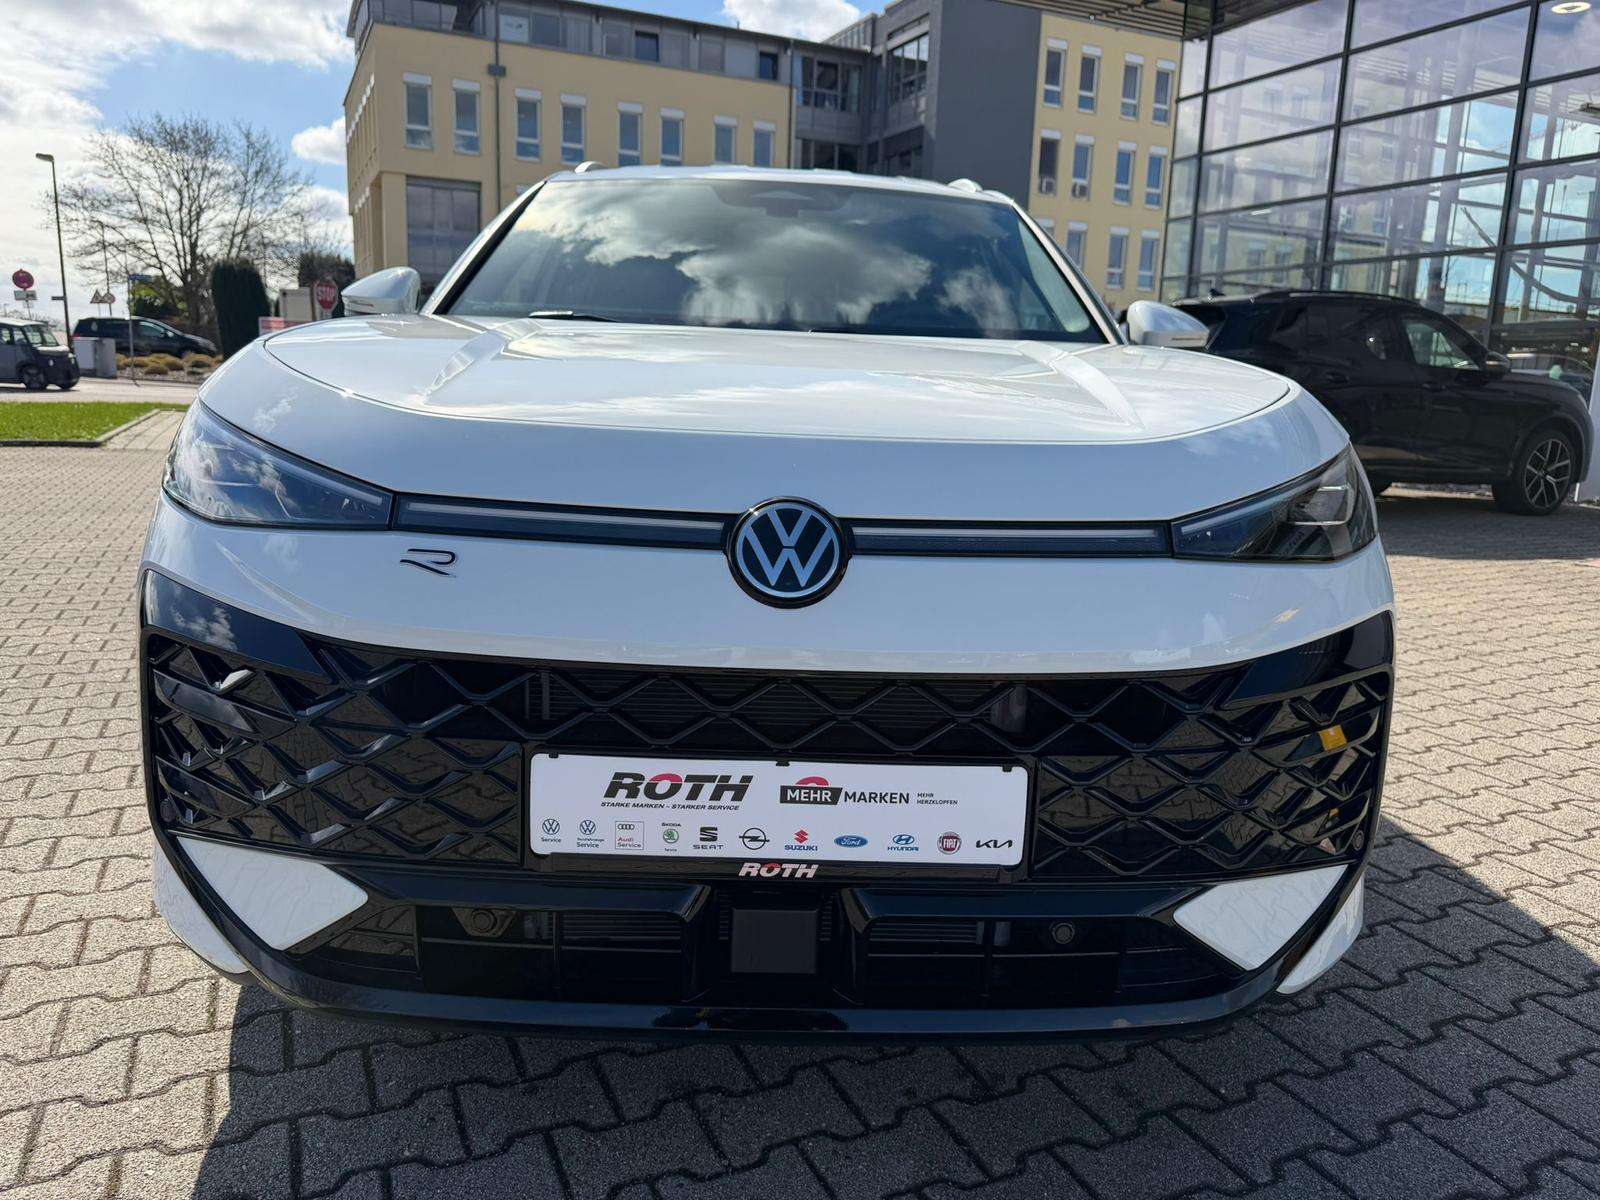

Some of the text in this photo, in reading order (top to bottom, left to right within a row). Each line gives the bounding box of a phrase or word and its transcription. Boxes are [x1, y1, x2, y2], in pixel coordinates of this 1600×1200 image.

[317, 286, 337, 300] STOP
[603, 771, 753, 802] ROTH
[786, 789, 910, 804] MEHR MARKEN
[841, 837, 861, 846] Ford
[943, 838, 957, 849] FIAT
[975, 839, 1013, 848] KIA
[738, 862, 819, 878] ROTH
